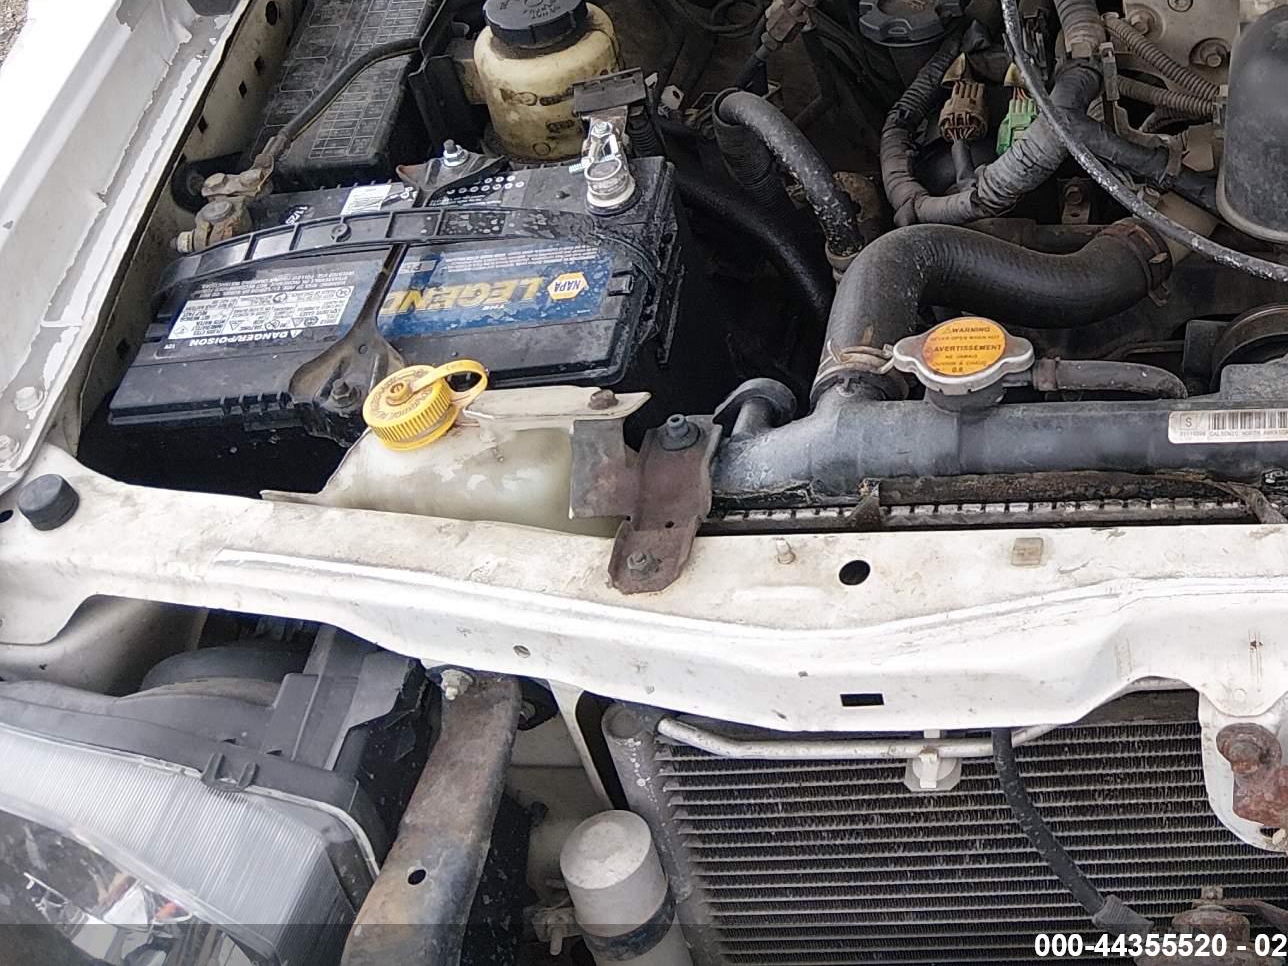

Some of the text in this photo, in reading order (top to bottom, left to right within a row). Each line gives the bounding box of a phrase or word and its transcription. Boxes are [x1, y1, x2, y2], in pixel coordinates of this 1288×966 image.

[554, 280, 582, 292] NAPA
[379, 276, 545, 316] LEGEND
[934, 344, 1002, 352] AVERTISSEMENT
[1185, 417, 1192, 427] S
